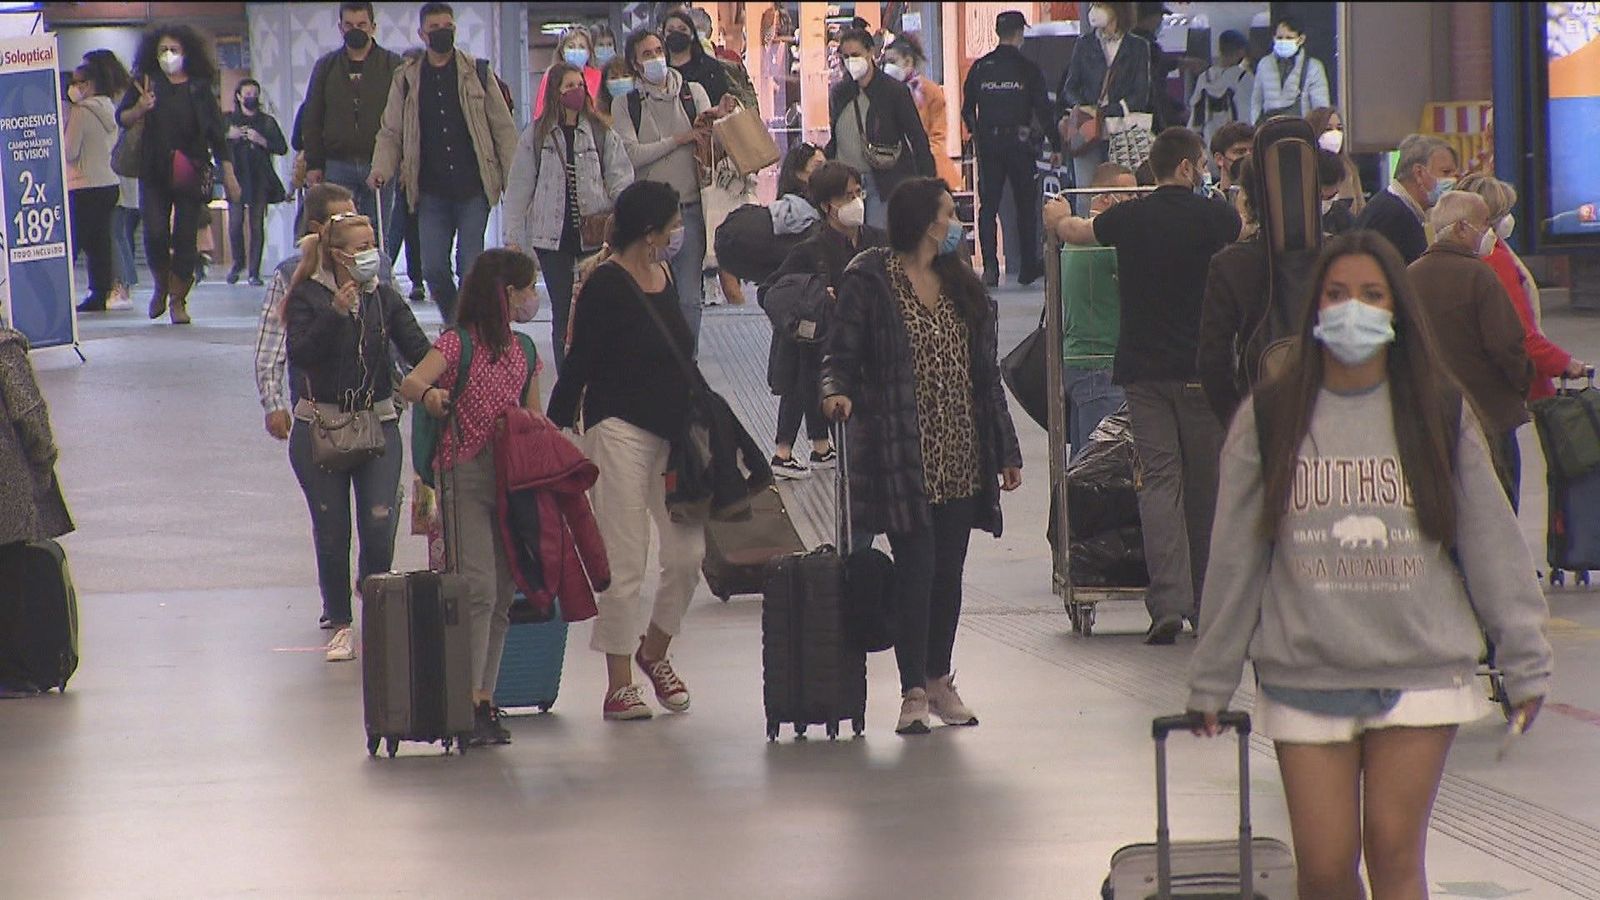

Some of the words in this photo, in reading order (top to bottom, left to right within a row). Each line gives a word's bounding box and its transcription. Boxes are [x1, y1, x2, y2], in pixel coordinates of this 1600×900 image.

[4, 46, 54, 66] Soloptical
[980, 81, 1020, 90] POLICIA
[0, 113, 57, 131] PROGRESIVOS
[23, 129, 37, 138] CON
[8, 140, 29, 150] CAMPO
[13, 150, 25, 161] DE
[19, 170, 47, 205] 2x
[13, 205, 61, 245] 189€
